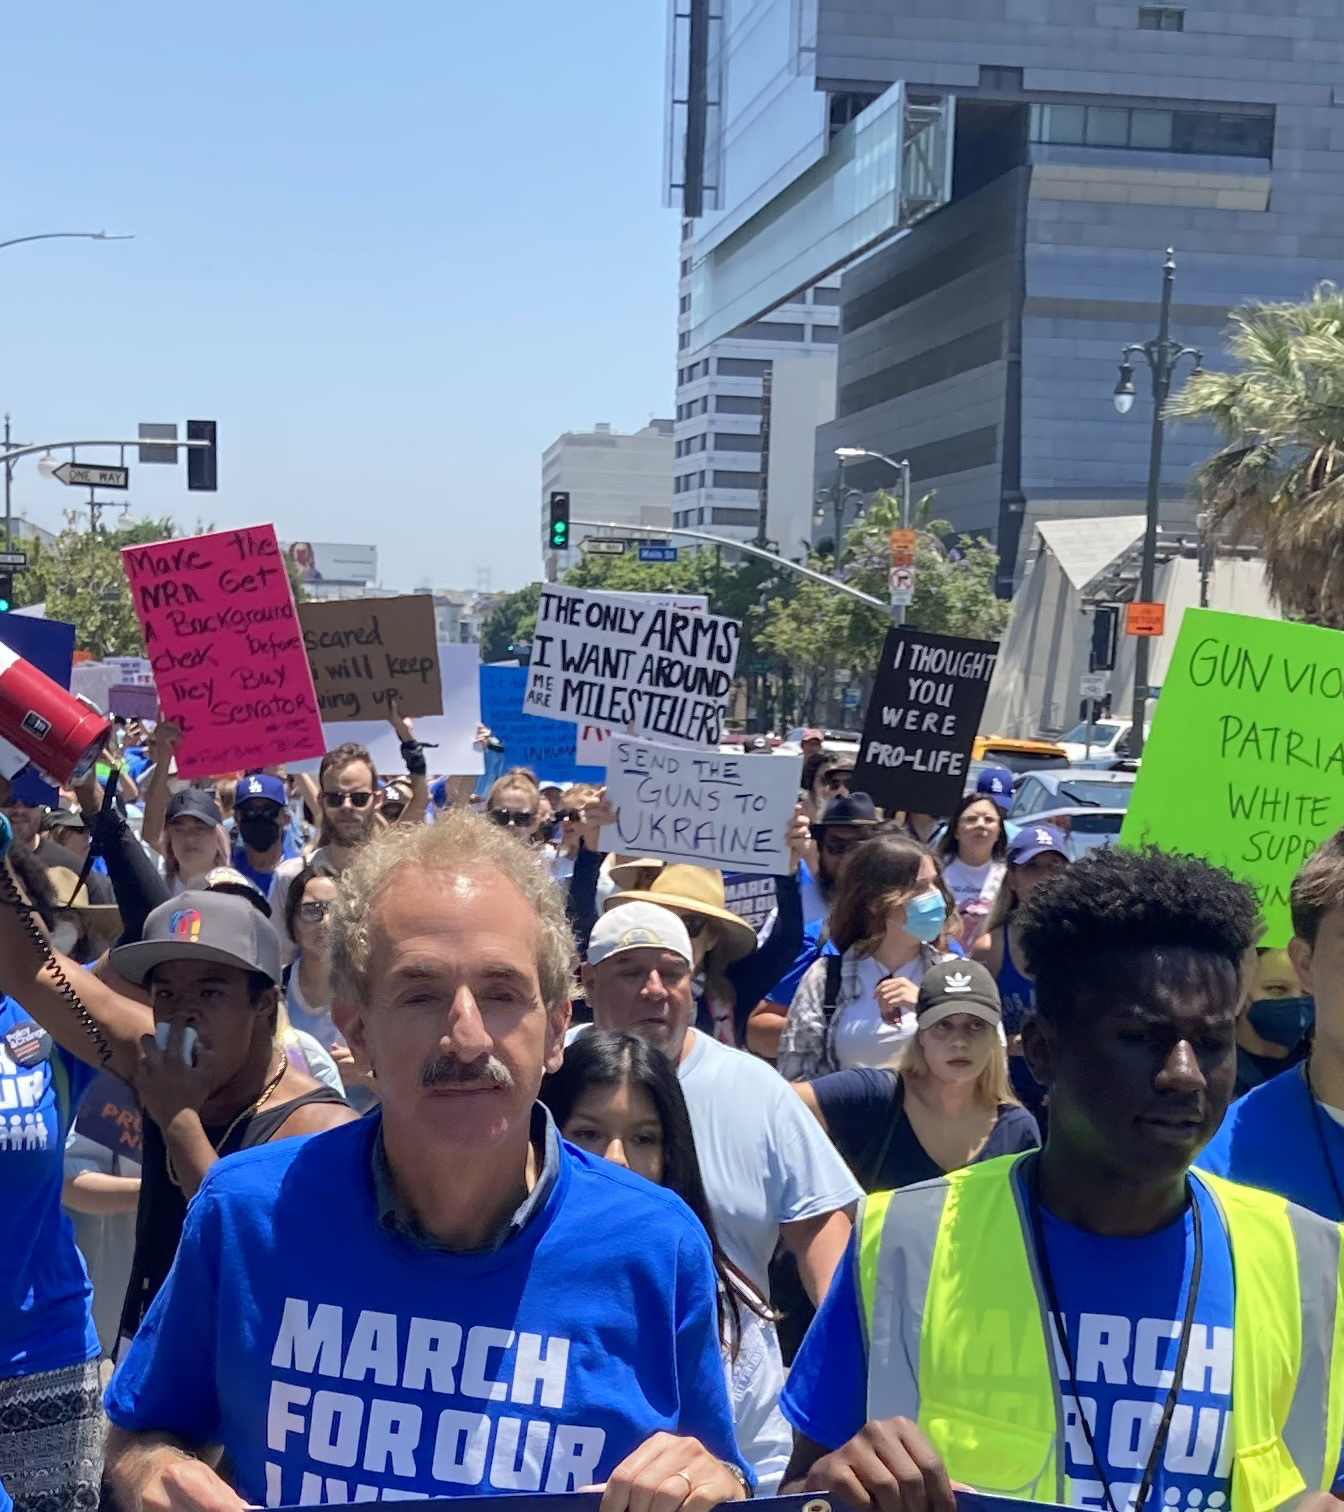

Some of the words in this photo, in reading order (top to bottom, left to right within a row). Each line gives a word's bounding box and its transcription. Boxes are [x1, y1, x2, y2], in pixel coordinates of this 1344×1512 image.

[69, 469, 90, 481] ONE
[99, 472, 122, 483] WAY
[140, 581, 203, 613] NRA
[218, 567, 279, 594] Get
[144, 621, 159, 643] A
[304, 616, 384, 652] scared
[541, 592, 584, 626] THE
[586, 602, 644, 635] ONLY
[641, 610, 741, 664] ARMS
[230, 664, 286, 691] Buy
[325, 654, 373, 680] will
[386, 653, 435, 684] keep
[533, 635, 554, 668] I
[561, 639, 636, 680] WANT
[637, 654, 731, 698] AROUND
[893, 641, 905, 669] I
[909, 644, 997, 682] THOUGHT
[1188, 637, 1273, 692] GUN
[526, 690, 552, 708] ARE
[533, 674, 554, 691] ME
[907, 677, 954, 708] YOU
[882, 705, 956, 736] WERE
[618, 743, 680, 774] SEND
[692, 760, 741, 778] THE
[865, 741, 964, 776] PRO-LIFE
[637, 777, 720, 812] GUNS
[735, 793, 768, 814] TO
[1228, 782, 1332, 827] WHITE
[616, 806, 781, 854] UKRAINE
[270, 1297, 570, 1409] MARCH
[267, 1381, 423, 1478] FOR
[434, 1409, 607, 1493] OUR
